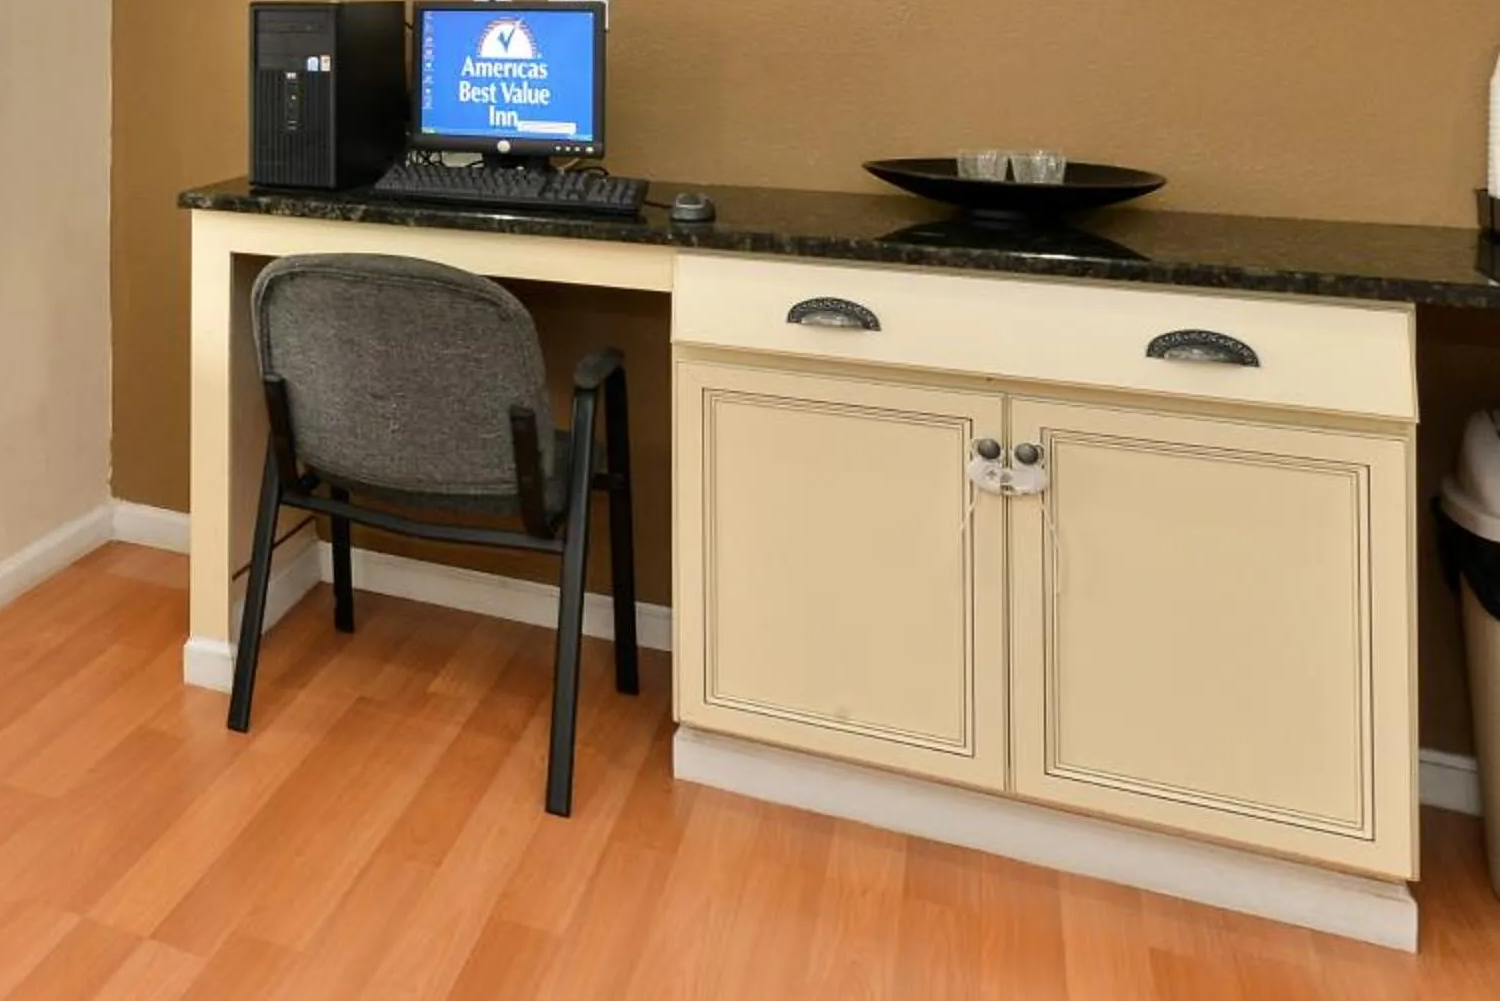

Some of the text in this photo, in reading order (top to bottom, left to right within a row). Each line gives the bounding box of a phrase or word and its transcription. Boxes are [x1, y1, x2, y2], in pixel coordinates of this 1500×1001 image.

[461, 56, 548, 80] Americas
[460, 81, 550, 105] Best Value
[489, 105, 518, 128] Inn
